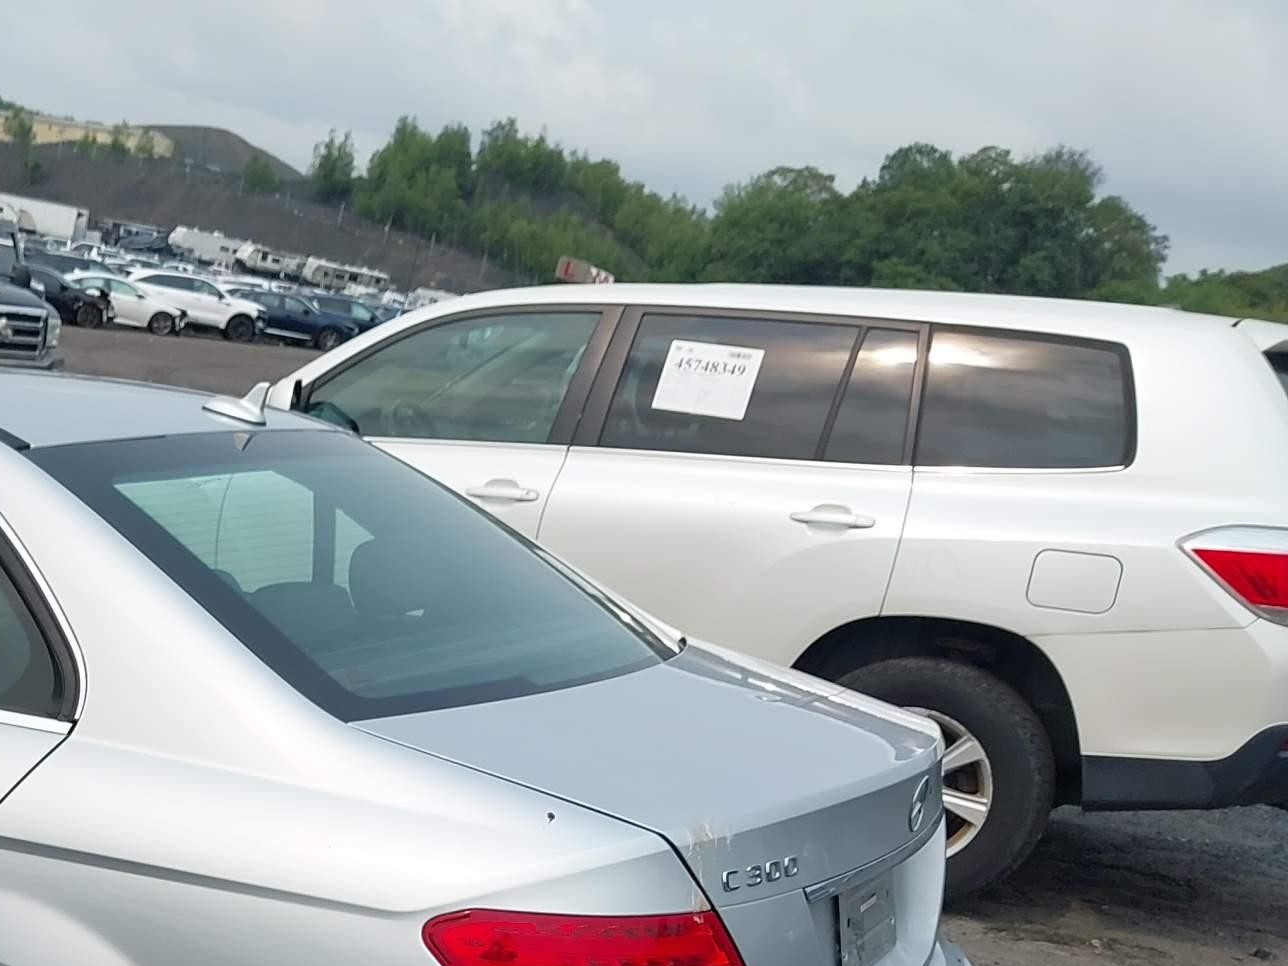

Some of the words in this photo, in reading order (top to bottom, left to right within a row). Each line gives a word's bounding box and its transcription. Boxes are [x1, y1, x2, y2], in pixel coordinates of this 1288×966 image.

[674, 357, 747, 376] 45748349
[722, 869, 741, 892] C
[746, 854, 799, 888] 300
